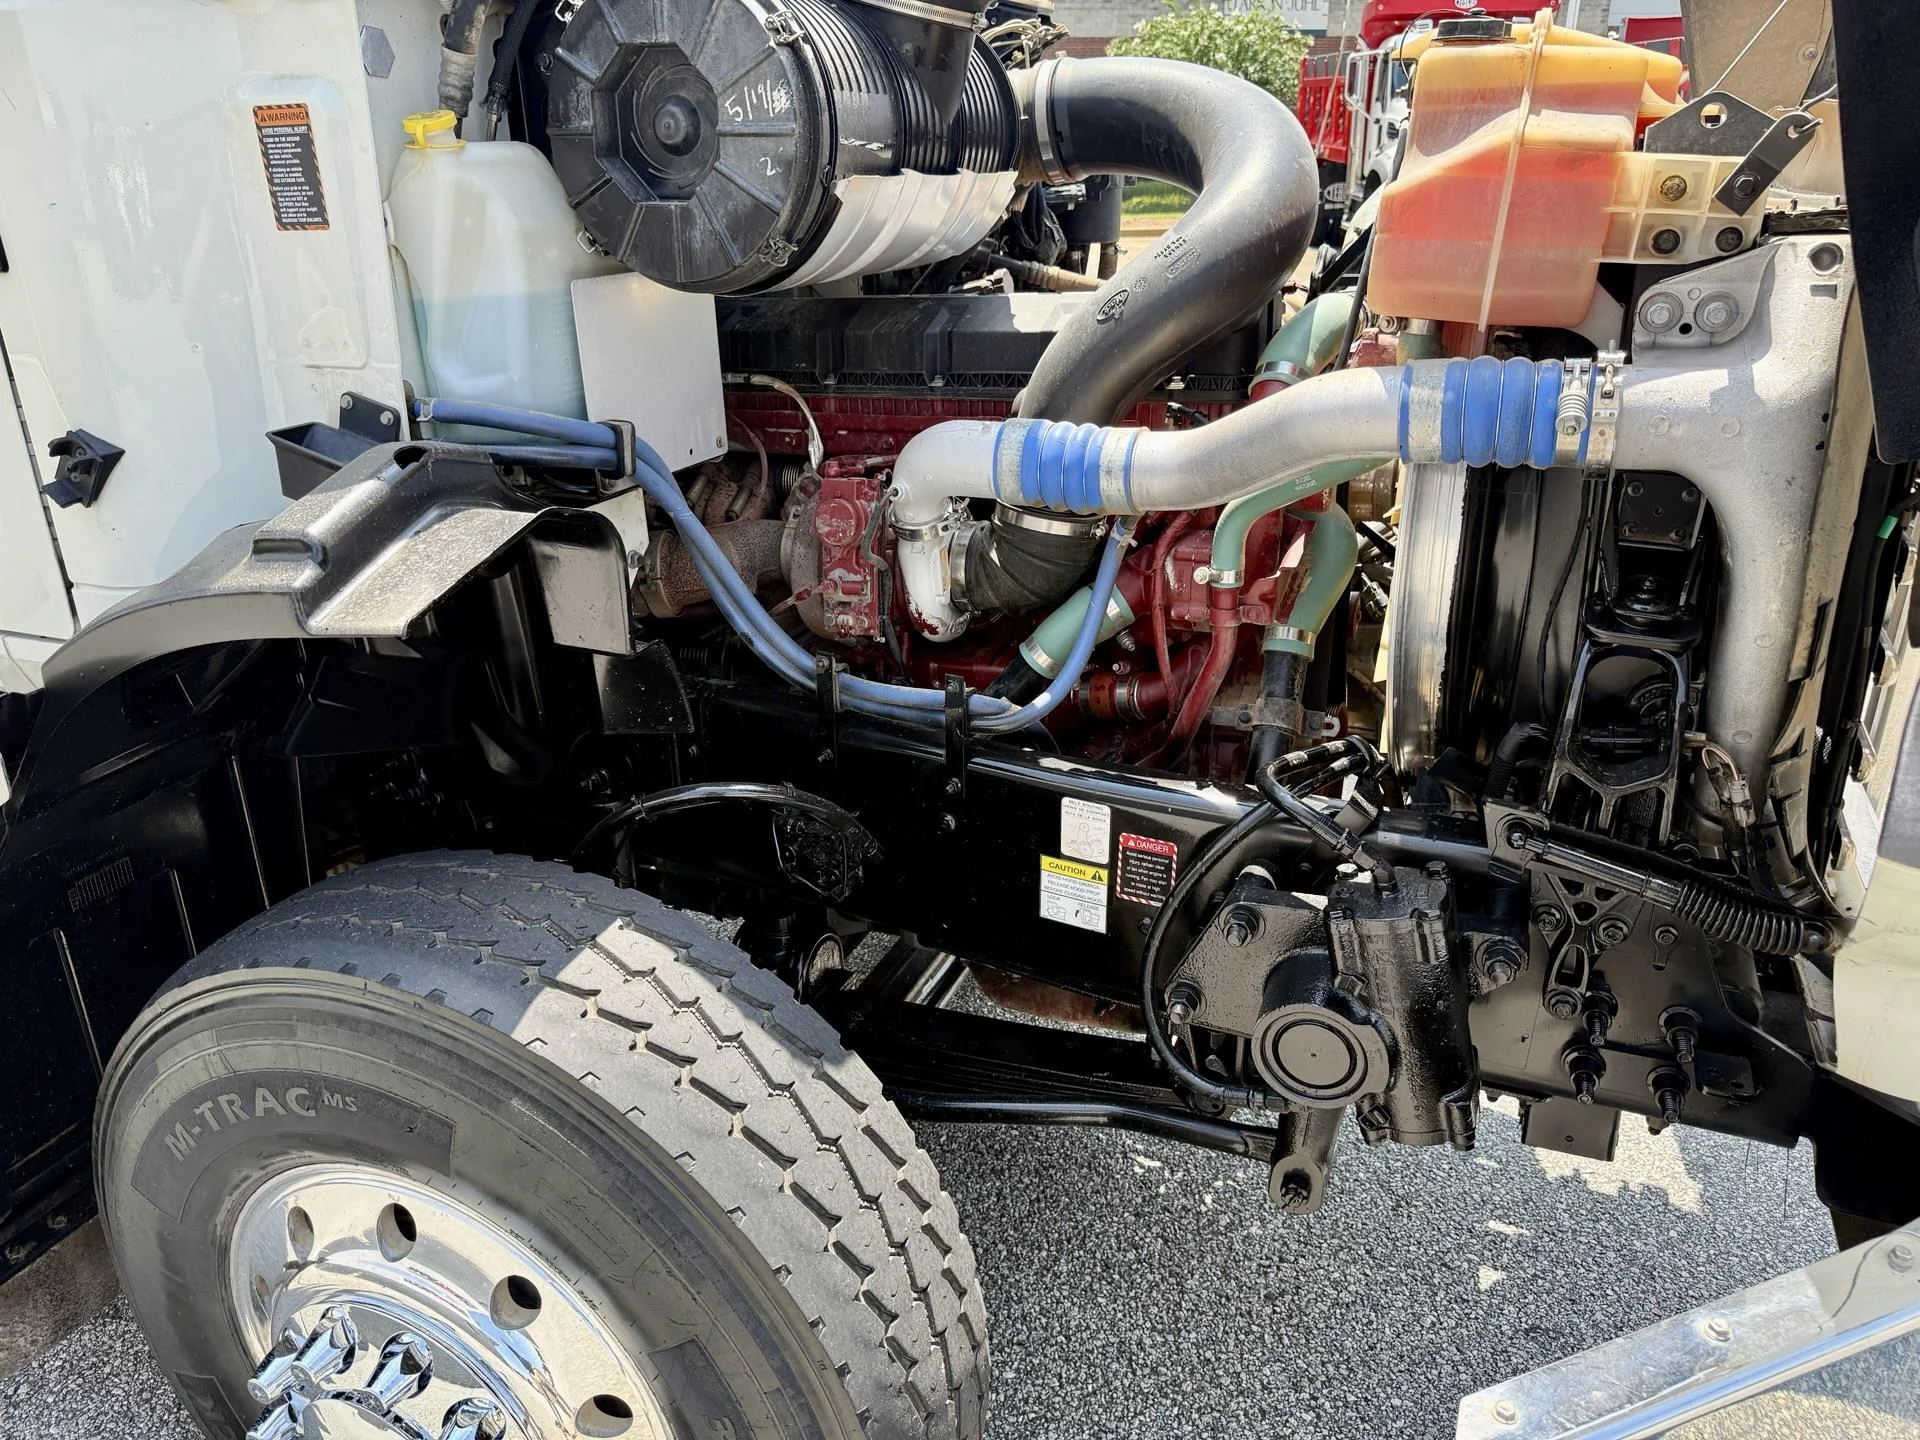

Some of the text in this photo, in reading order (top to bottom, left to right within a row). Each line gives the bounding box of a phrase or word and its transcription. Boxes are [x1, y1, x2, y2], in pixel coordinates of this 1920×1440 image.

[267, 112, 305, 121] WARNING
[1137, 841, 1168, 853] DANGER
[1049, 862, 1086, 876] CAUTION
[1048, 880, 1069, 888] RELEASE
[1064, 891, 1086, 899] CLOSING
[1078, 902, 1099, 910] RELEASE
[164, 1087, 359, 1162] M-TRAC MS
